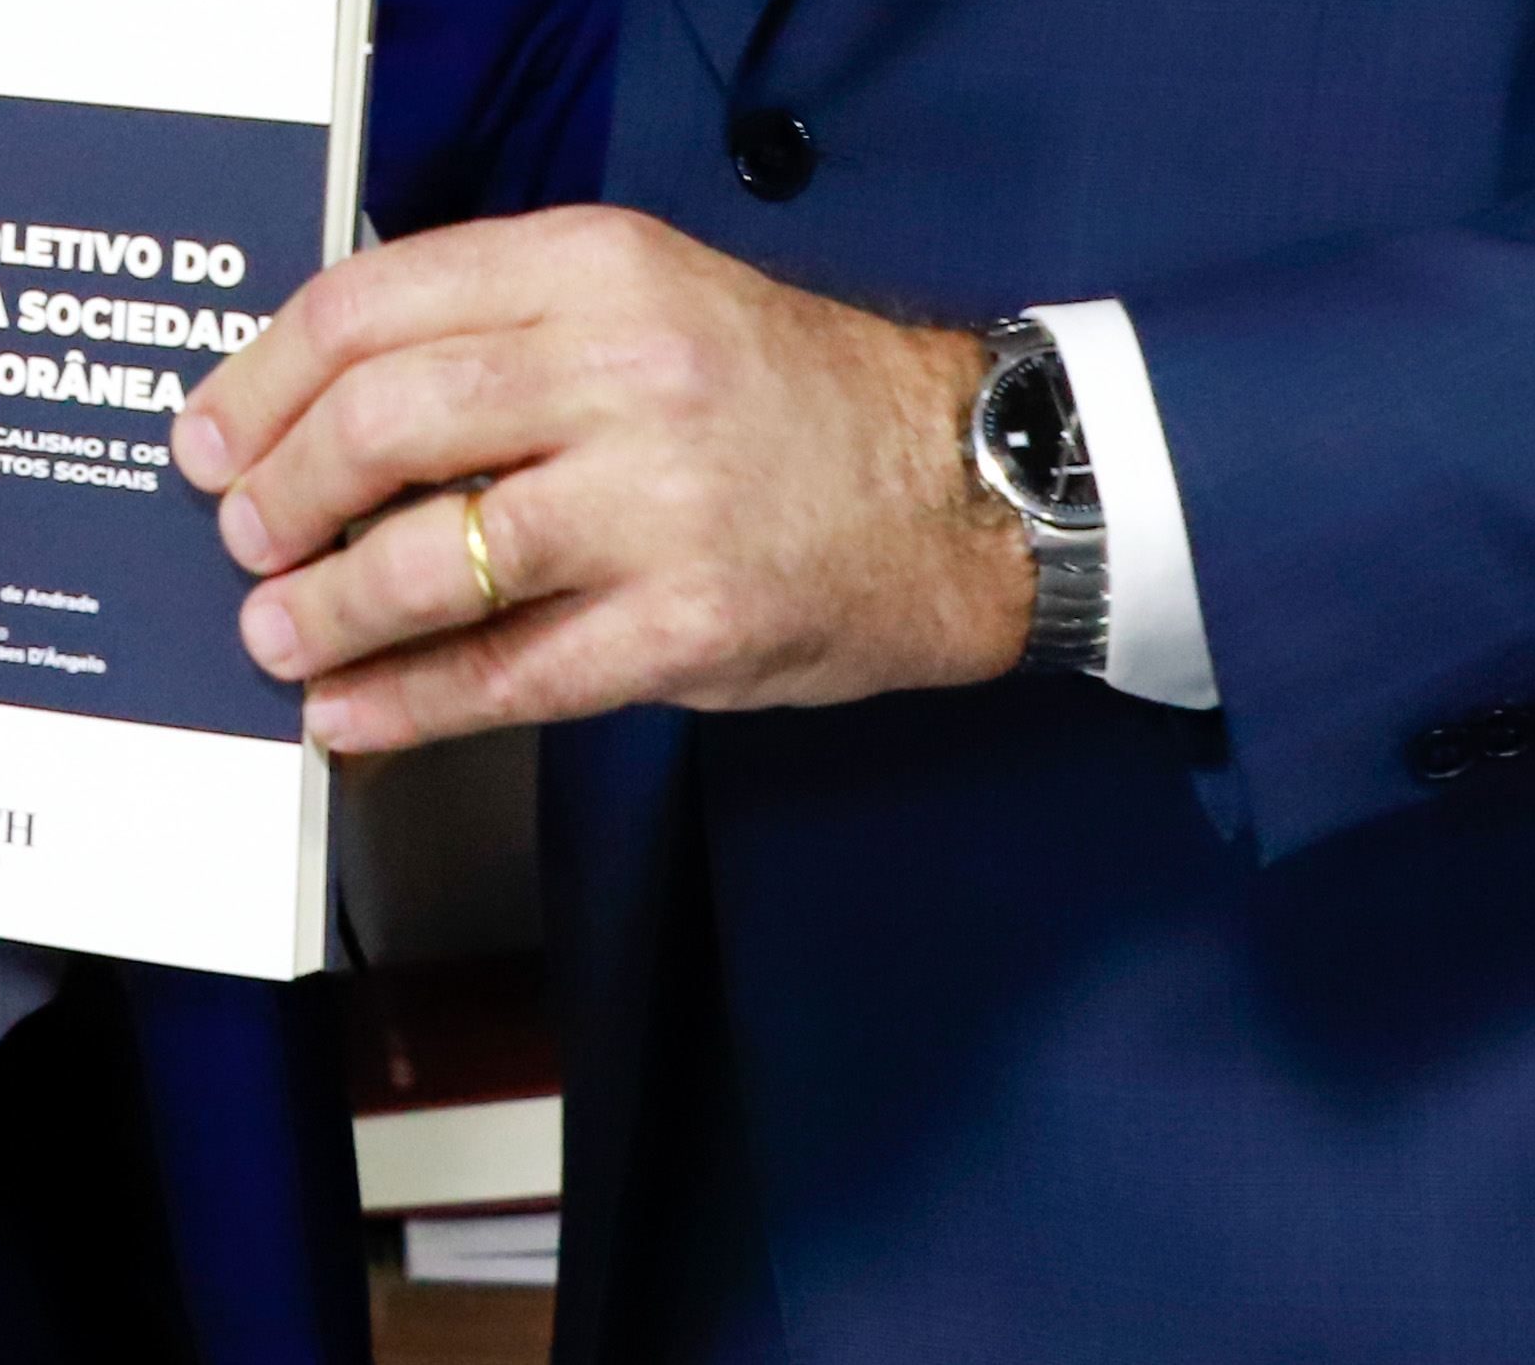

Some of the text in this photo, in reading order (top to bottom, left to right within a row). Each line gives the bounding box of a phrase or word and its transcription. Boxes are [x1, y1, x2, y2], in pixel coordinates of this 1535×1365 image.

[172, 240, 246, 287] DO
[17, 291, 274, 354] SOCIEDAD
[108, 440, 127, 462] E
[130, 443, 170, 466] OS
[53, 460, 158, 492] SOCIAIS
[0, 584, 25, 604] de
[25, 588, 101, 614] Andrade
